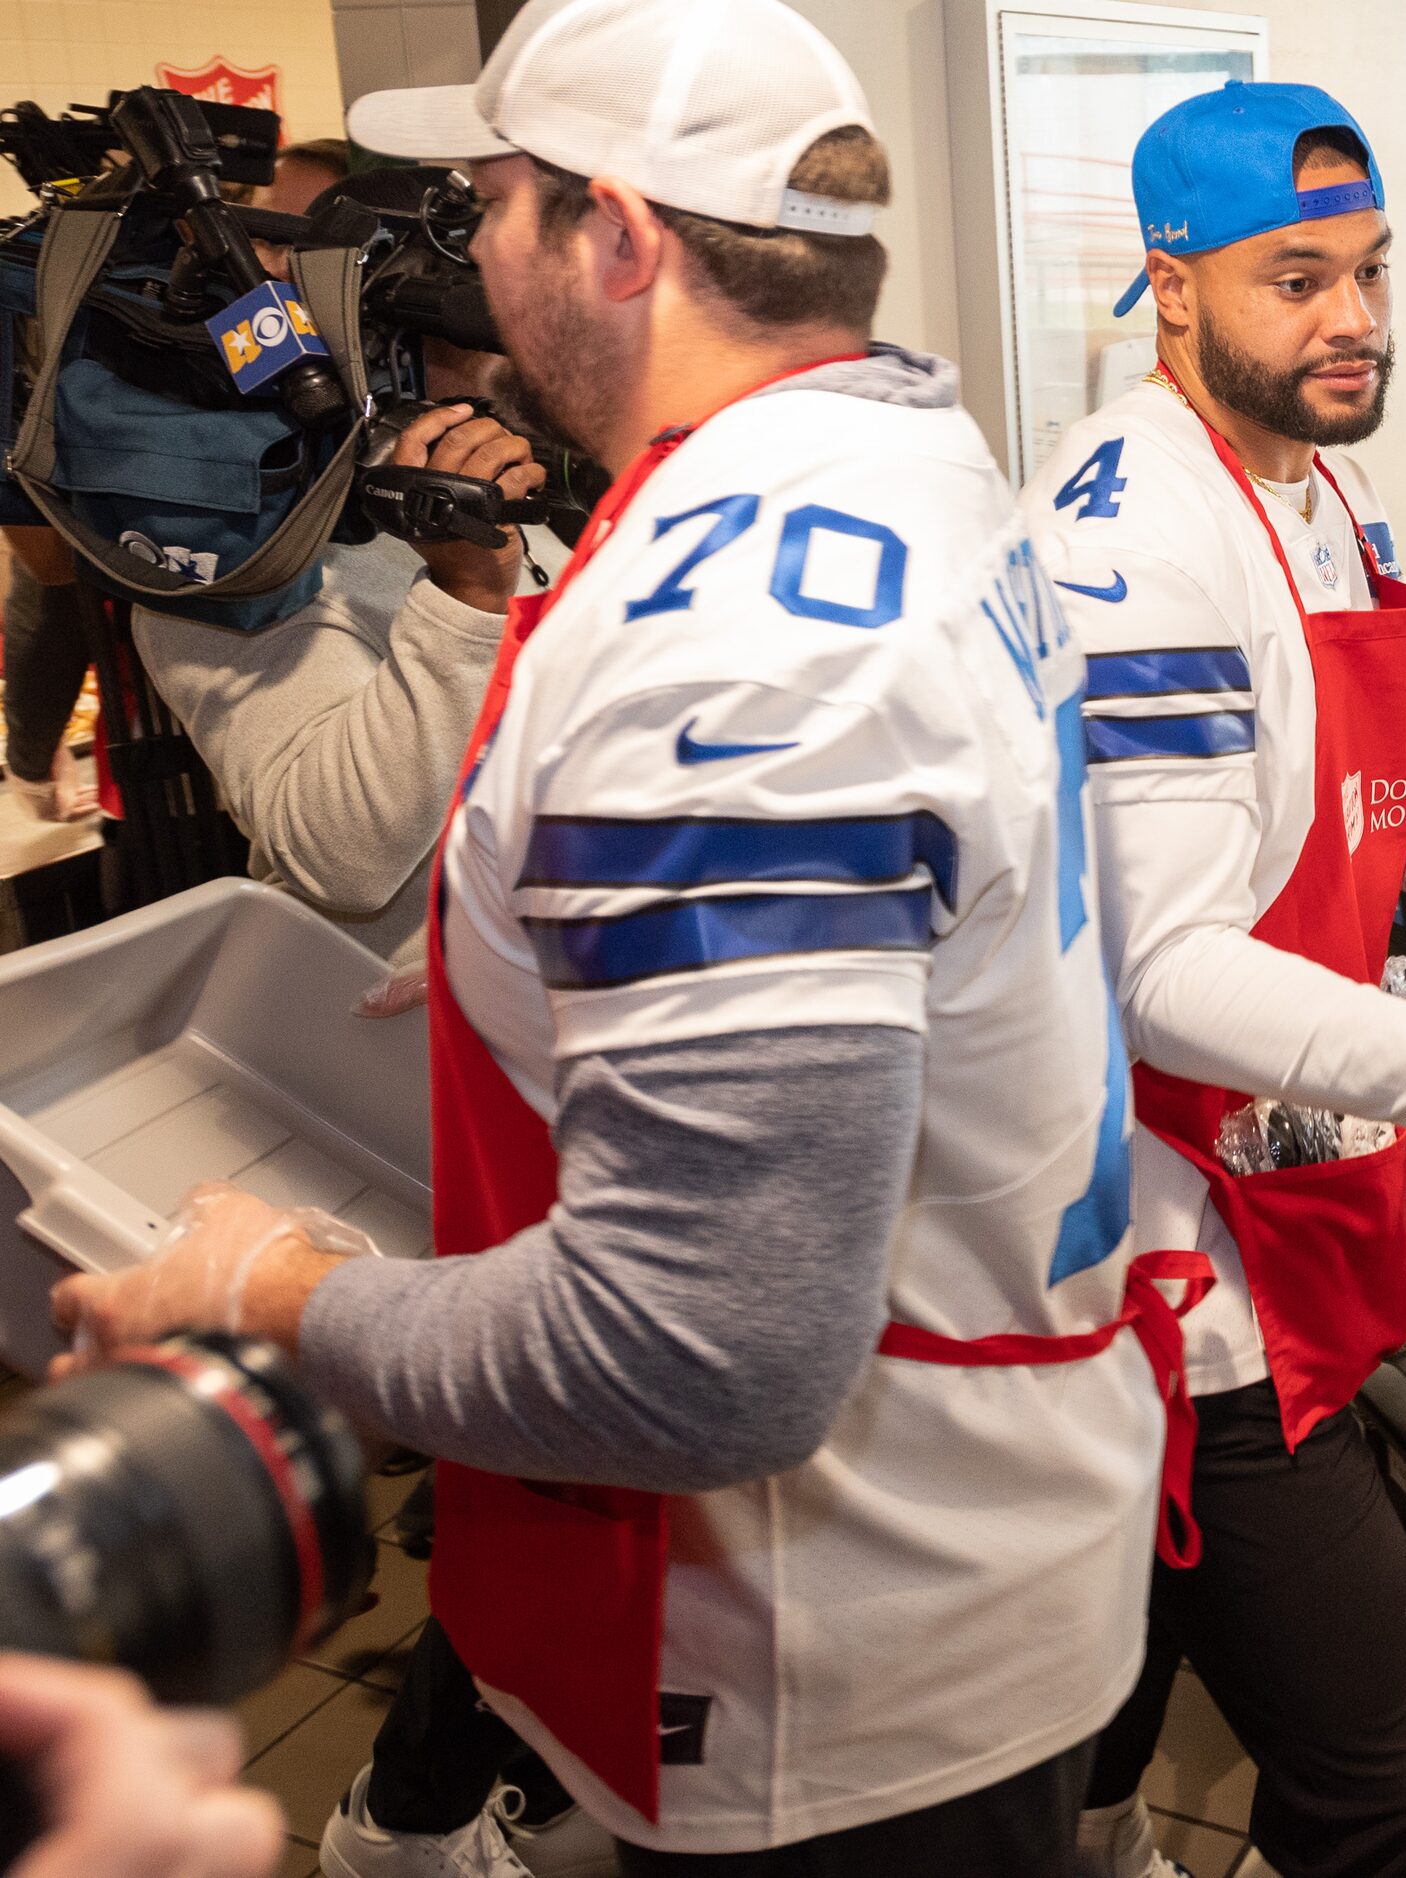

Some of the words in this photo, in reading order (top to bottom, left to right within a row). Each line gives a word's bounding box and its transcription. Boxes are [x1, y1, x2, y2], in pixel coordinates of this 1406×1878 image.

[365, 484, 404, 501] Canon
[1053, 436, 1127, 522] 4
[622, 493, 908, 629] 70
